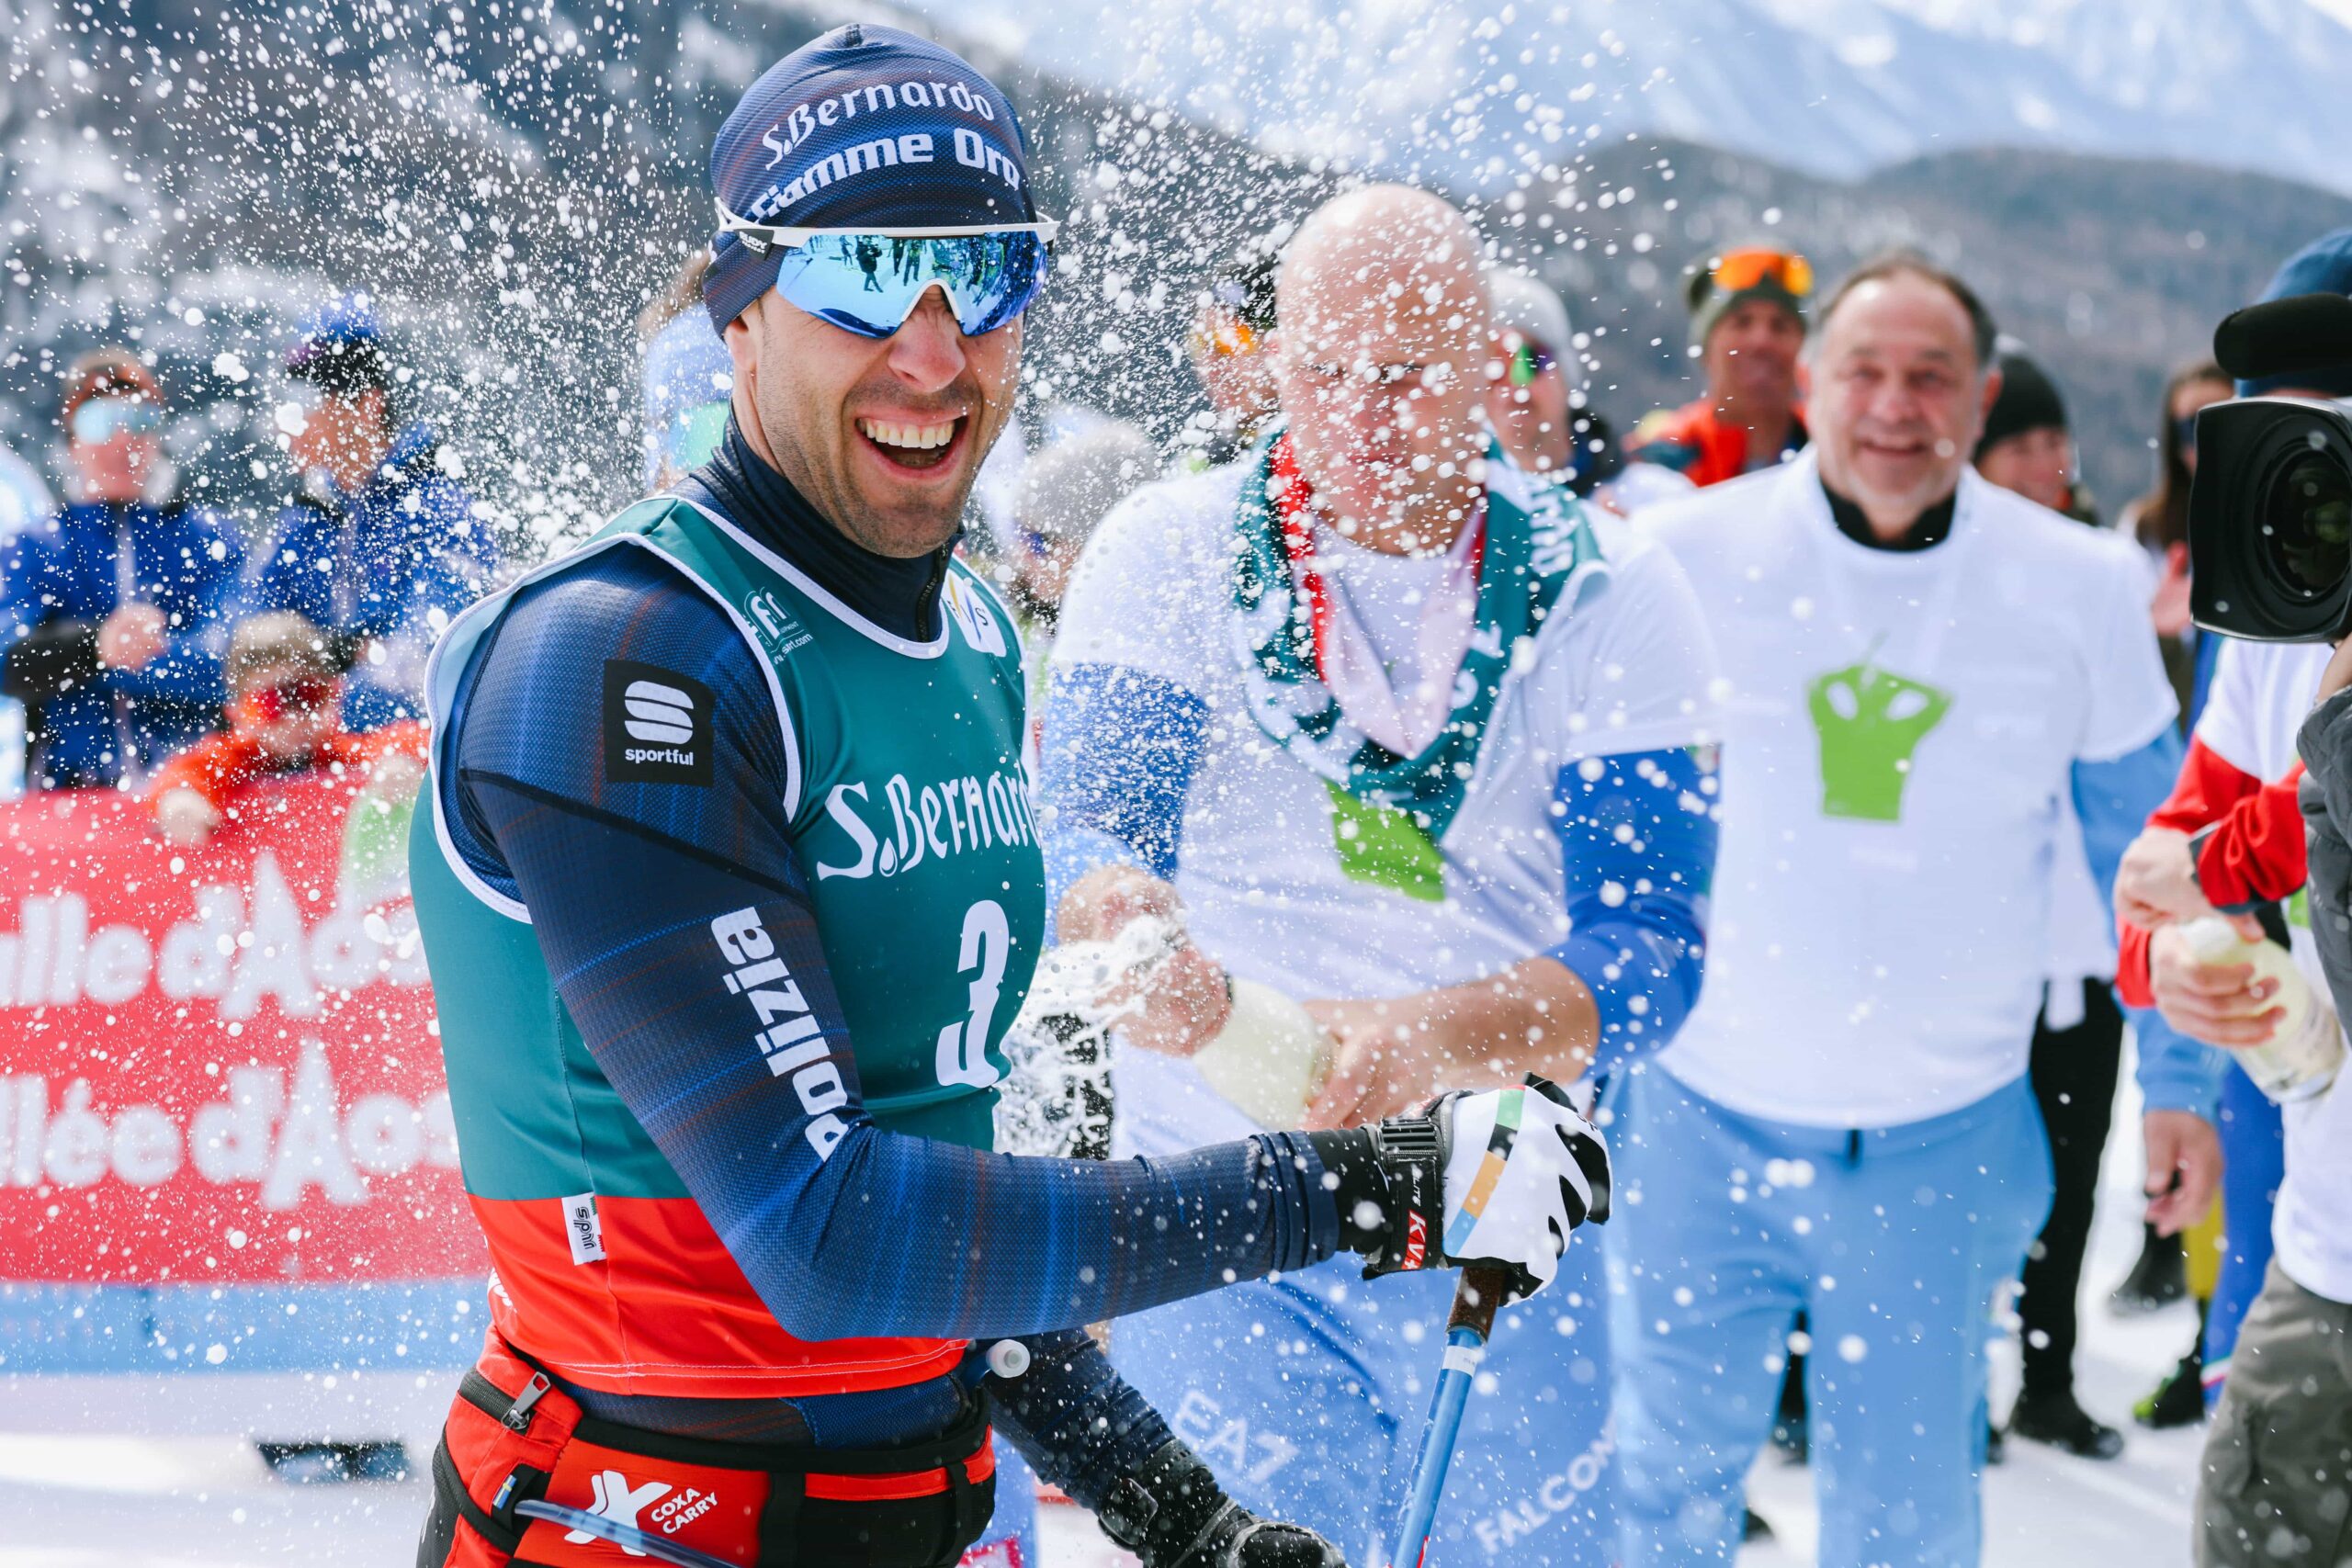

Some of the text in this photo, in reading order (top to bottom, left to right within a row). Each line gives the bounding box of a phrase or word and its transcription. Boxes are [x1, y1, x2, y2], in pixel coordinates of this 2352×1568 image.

[762, 82, 994, 171] S.Bernardo
[954, 128, 1021, 191] Oro
[625, 748, 695, 766] sportful
[934, 899, 1011, 1089] 3
[1175, 1390, 1302, 1485] EA7
[650, 1487, 701, 1522] COXA
[662, 1492, 718, 1535] CARRY
